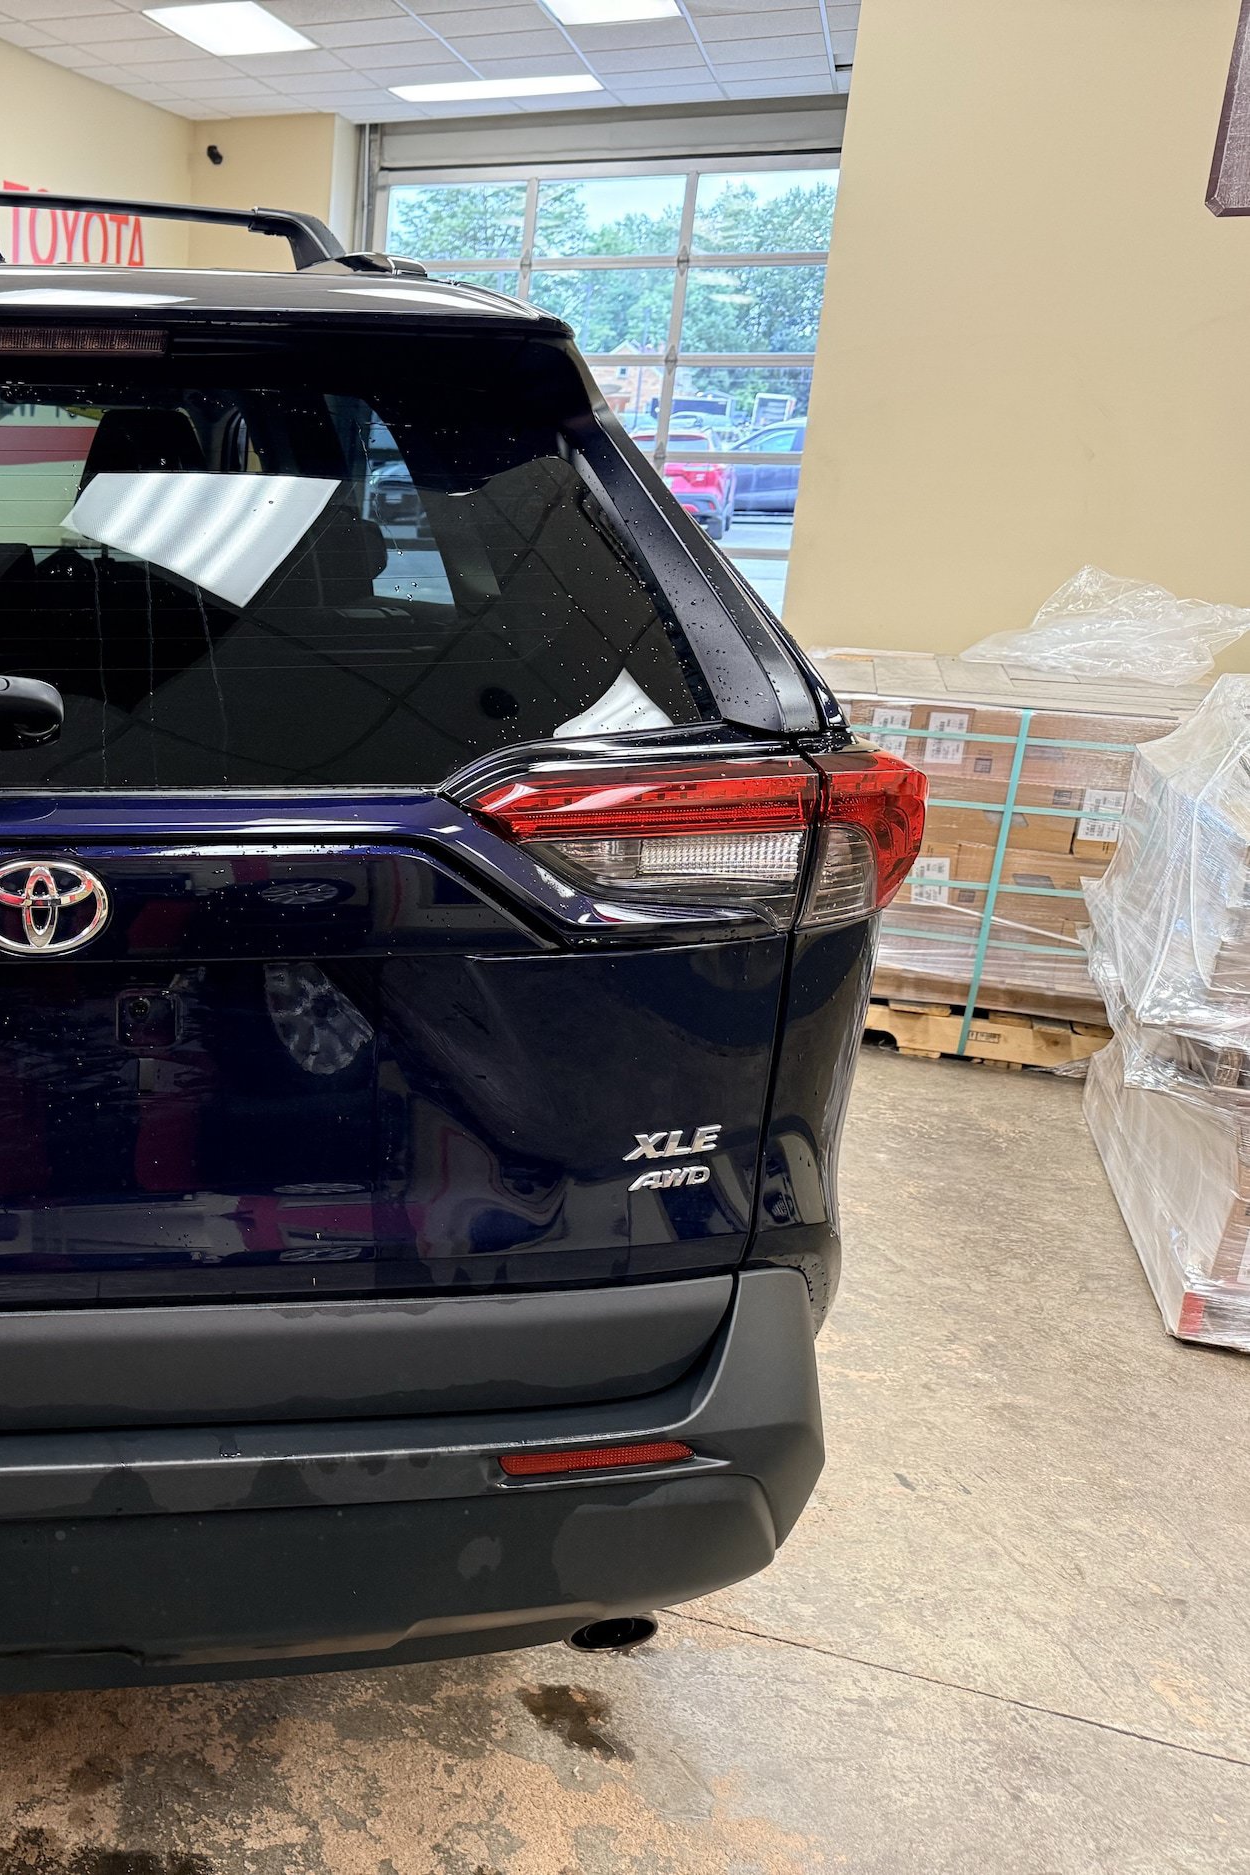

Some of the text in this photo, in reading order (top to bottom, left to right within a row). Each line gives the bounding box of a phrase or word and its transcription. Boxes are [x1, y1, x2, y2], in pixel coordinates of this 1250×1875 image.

[3, 180, 144, 266] TOYOTA
[622, 1124, 722, 1161] XLE
[628, 1165, 711, 1191] AWD
